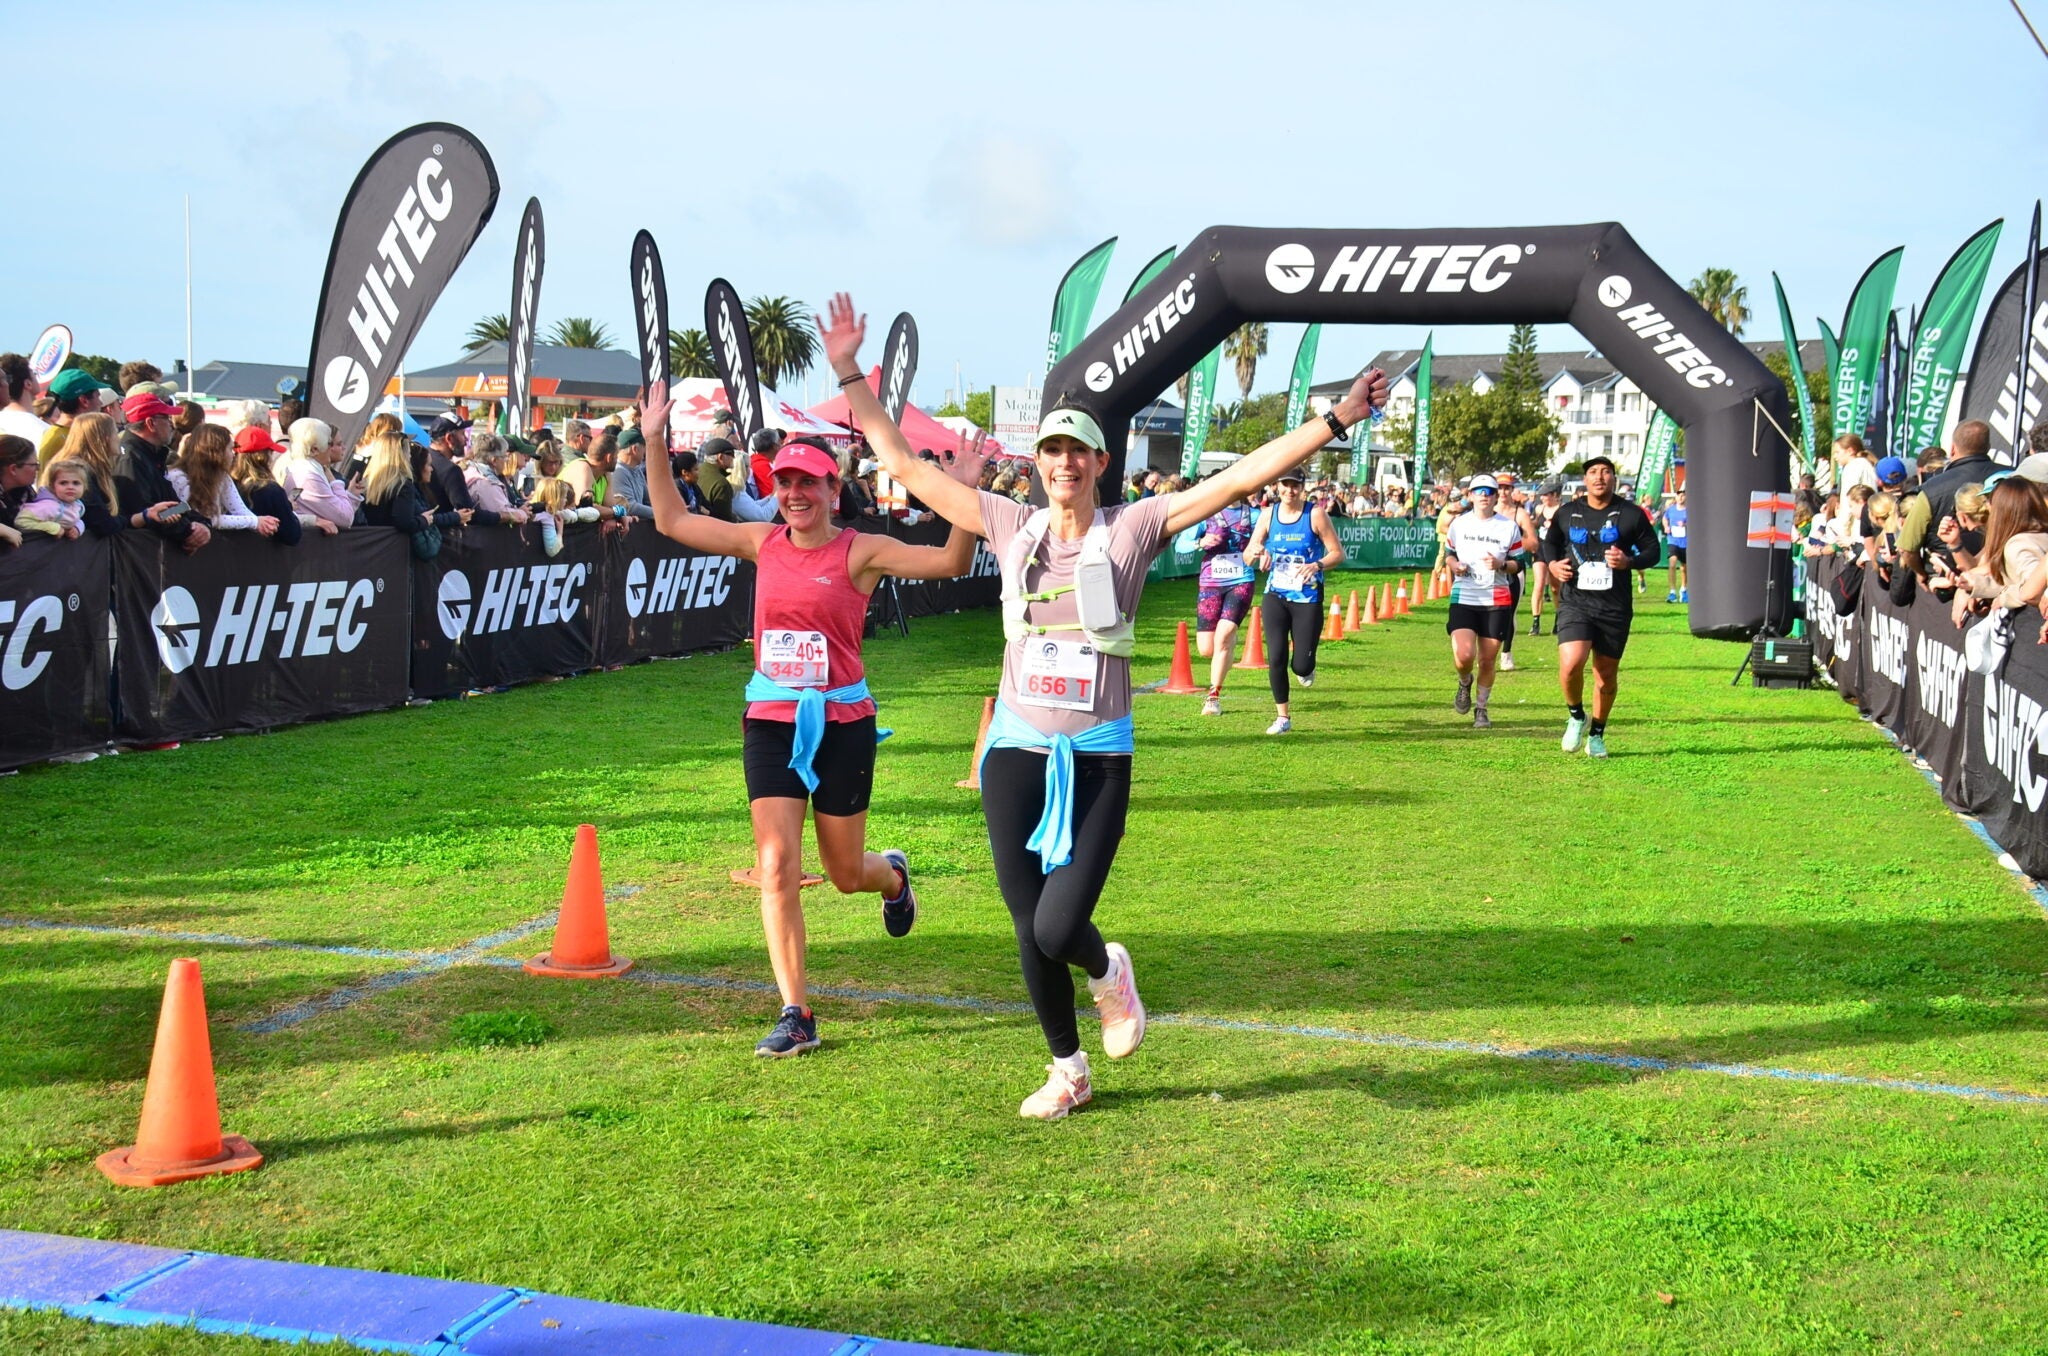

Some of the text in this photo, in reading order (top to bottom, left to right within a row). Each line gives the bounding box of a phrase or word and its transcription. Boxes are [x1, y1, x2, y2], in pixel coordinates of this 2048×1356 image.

[348, 157, 453, 369] HI-TEC
[1318, 243, 1522, 293] HI-TEC
[1112, 278, 1196, 376] HI-TEC
[1616, 302, 1727, 389] HI-TEC
[1186, 371, 1203, 438] LOVER'S
[1836, 347, 1859, 435] LOVER'S
[1914, 363, 1954, 456] MARKET
[1653, 423, 1675, 475] MARKET
[1379, 526, 1403, 542] FOOD
[1393, 544, 1429, 559] MARKET
[472, 562, 586, 635] HI-TEC
[646, 555, 737, 614] HI-TEC
[204, 578, 375, 667] HI-TEC
[795, 642, 824, 661] 40+
[769, 661, 826, 678] 345 T
[1028, 674, 1092, 698] 656 T
